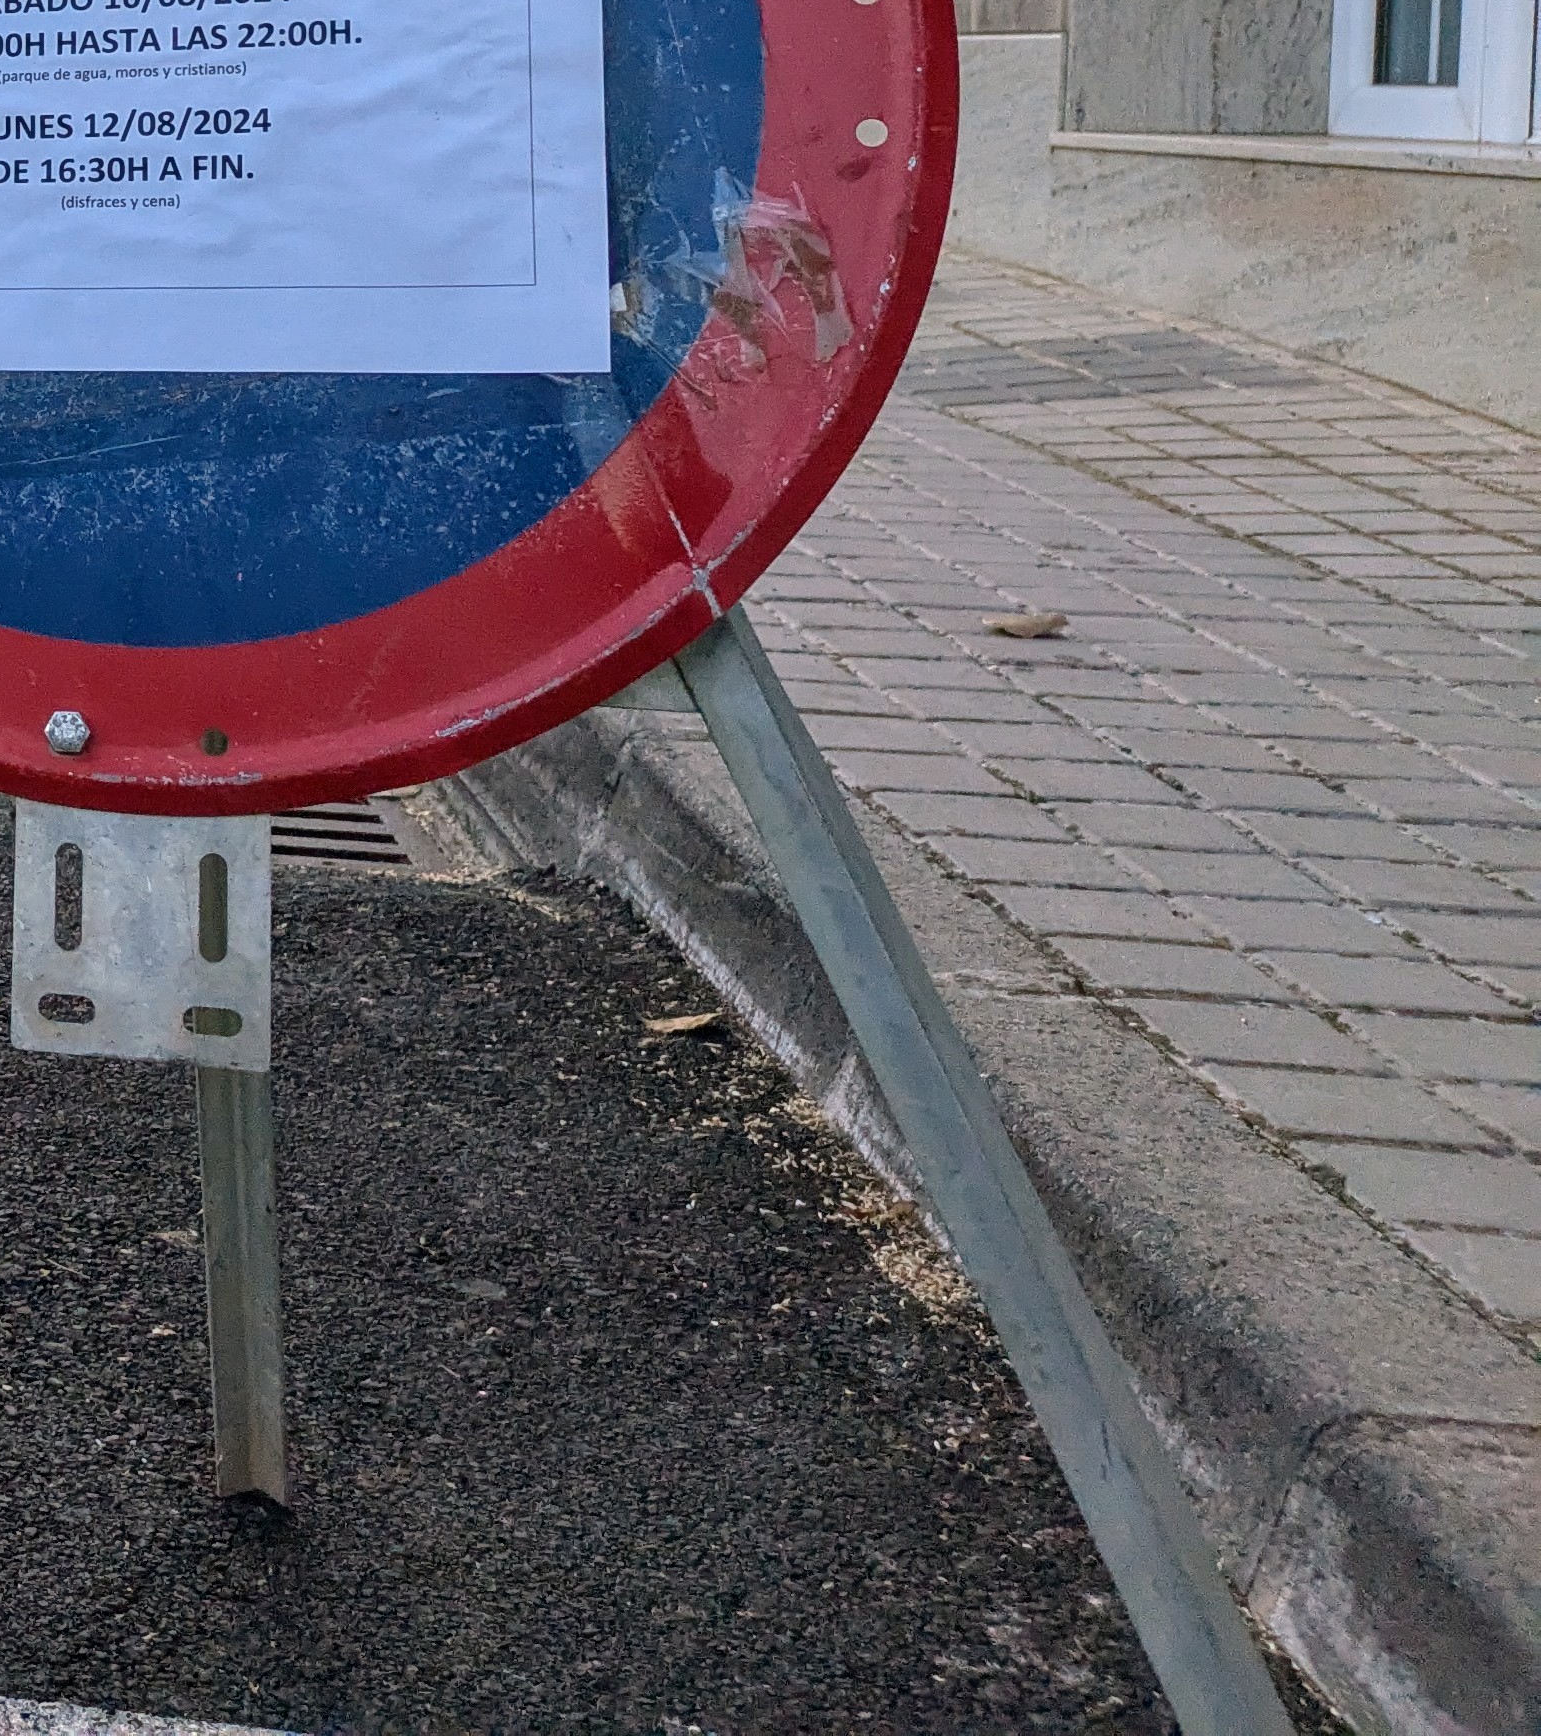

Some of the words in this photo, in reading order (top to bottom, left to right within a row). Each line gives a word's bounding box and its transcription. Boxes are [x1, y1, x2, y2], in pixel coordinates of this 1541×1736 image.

[56, 27, 161, 57] HASTA
[172, 24, 228, 52] LAS
[237, 19, 363, 49] 22:00H.
[53, 67, 70, 81] de
[74, 68, 112, 82] agua,
[116, 66, 159, 78] moros
[162, 65, 171, 79] y
[174, 61, 247, 76] cristianos)
[84, 107, 272, 142] 12/08/2024
[40, 157, 149, 183] 16:30H
[158, 155, 182, 182] A
[193, 153, 255, 181] FIN.
[61, 194, 127, 211] (disfraces
[131, 197, 139, 210] y
[142, 194, 180, 210] cena)
